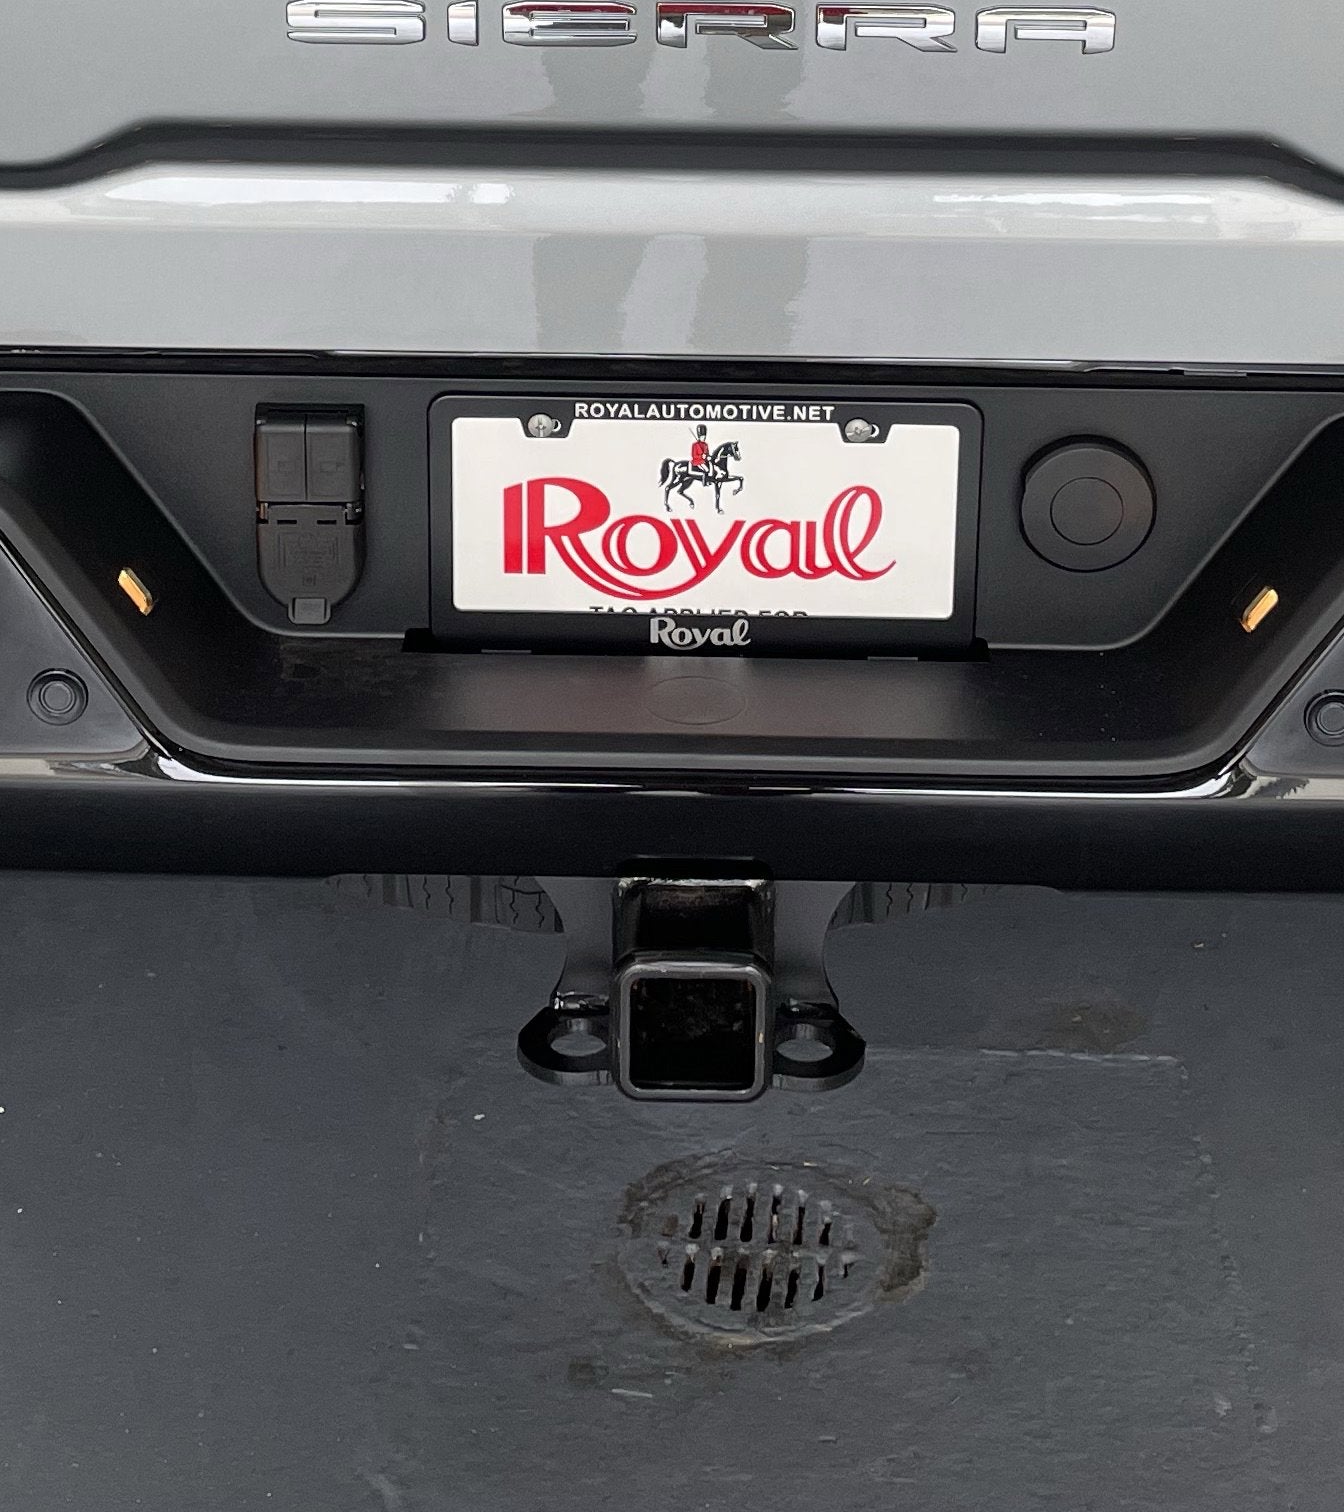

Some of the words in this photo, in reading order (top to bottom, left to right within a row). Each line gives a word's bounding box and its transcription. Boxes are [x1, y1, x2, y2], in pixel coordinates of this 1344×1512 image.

[574, 401, 836, 422] ROYALAUTOMOTIVE.NET
[503, 476, 896, 601] Royal
[649, 616, 752, 651] Royal
